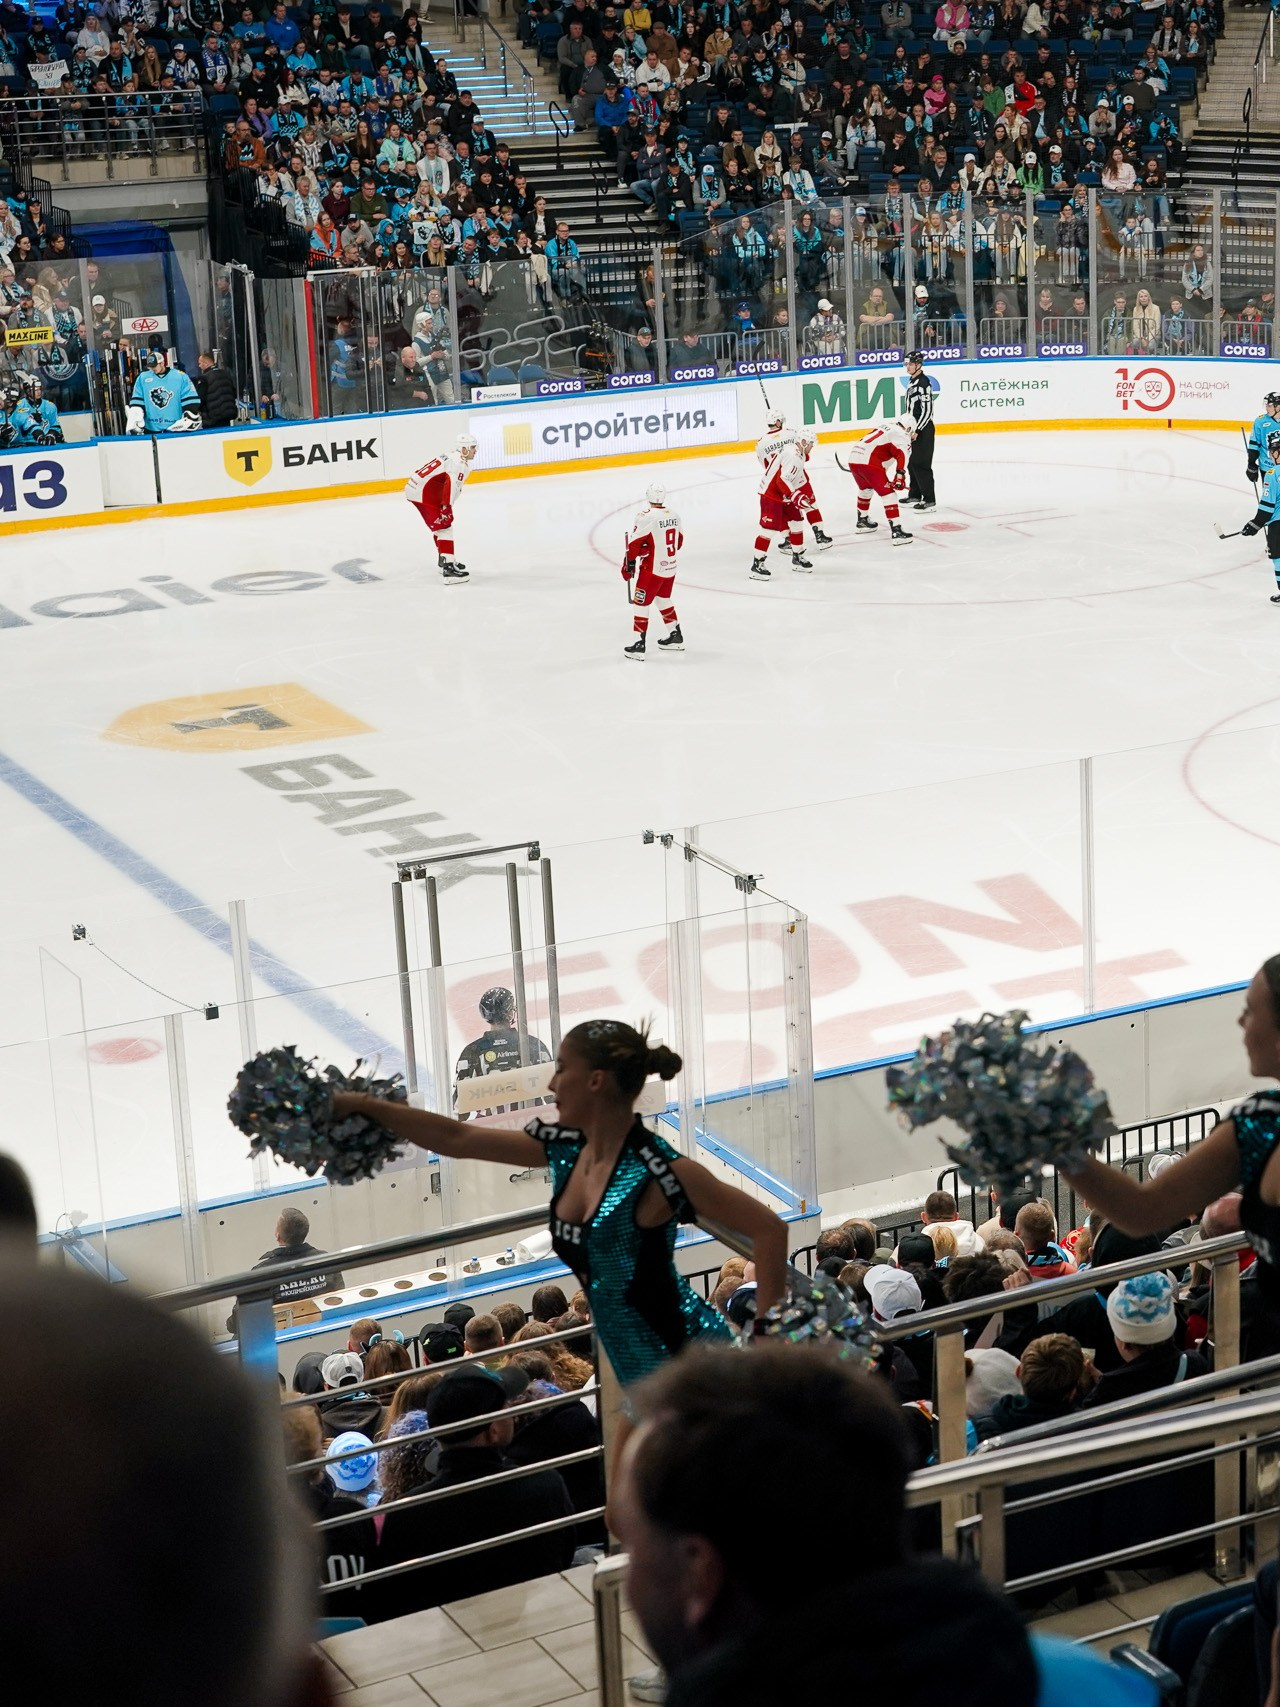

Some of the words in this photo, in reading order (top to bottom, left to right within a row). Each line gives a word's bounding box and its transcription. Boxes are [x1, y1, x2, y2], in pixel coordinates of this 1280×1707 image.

[858, 350, 900, 365] согаз
[919, 347, 961, 361] согаз
[979, 344, 1023, 358] согаз
[1041, 344, 1085, 357] согаз
[1223, 343, 1267, 358] согаз
[739, 362, 779, 377] согаз
[801, 355, 843, 370] согаз
[611, 373, 652, 388] согаз
[673, 367, 715, 381] согаз
[540, 380, 582, 394] согаз
[959, 378, 1049, 393] Платёжная
[1116, 382, 1135, 390] FON
[1180, 382, 1193, 390] НА
[1195, 381, 1230, 390] ОДНОЙ
[1180, 391, 1213, 399] ЛИНИИ
[959, 396, 1026, 410] система
[542, 408, 715, 448] стройтегия.
[237, 451, 259, 472] Т
[283, 438, 379, 468] БАНК
[240, 753, 537, 894] БАНК
[555, 1221, 582, 1245] ICE
